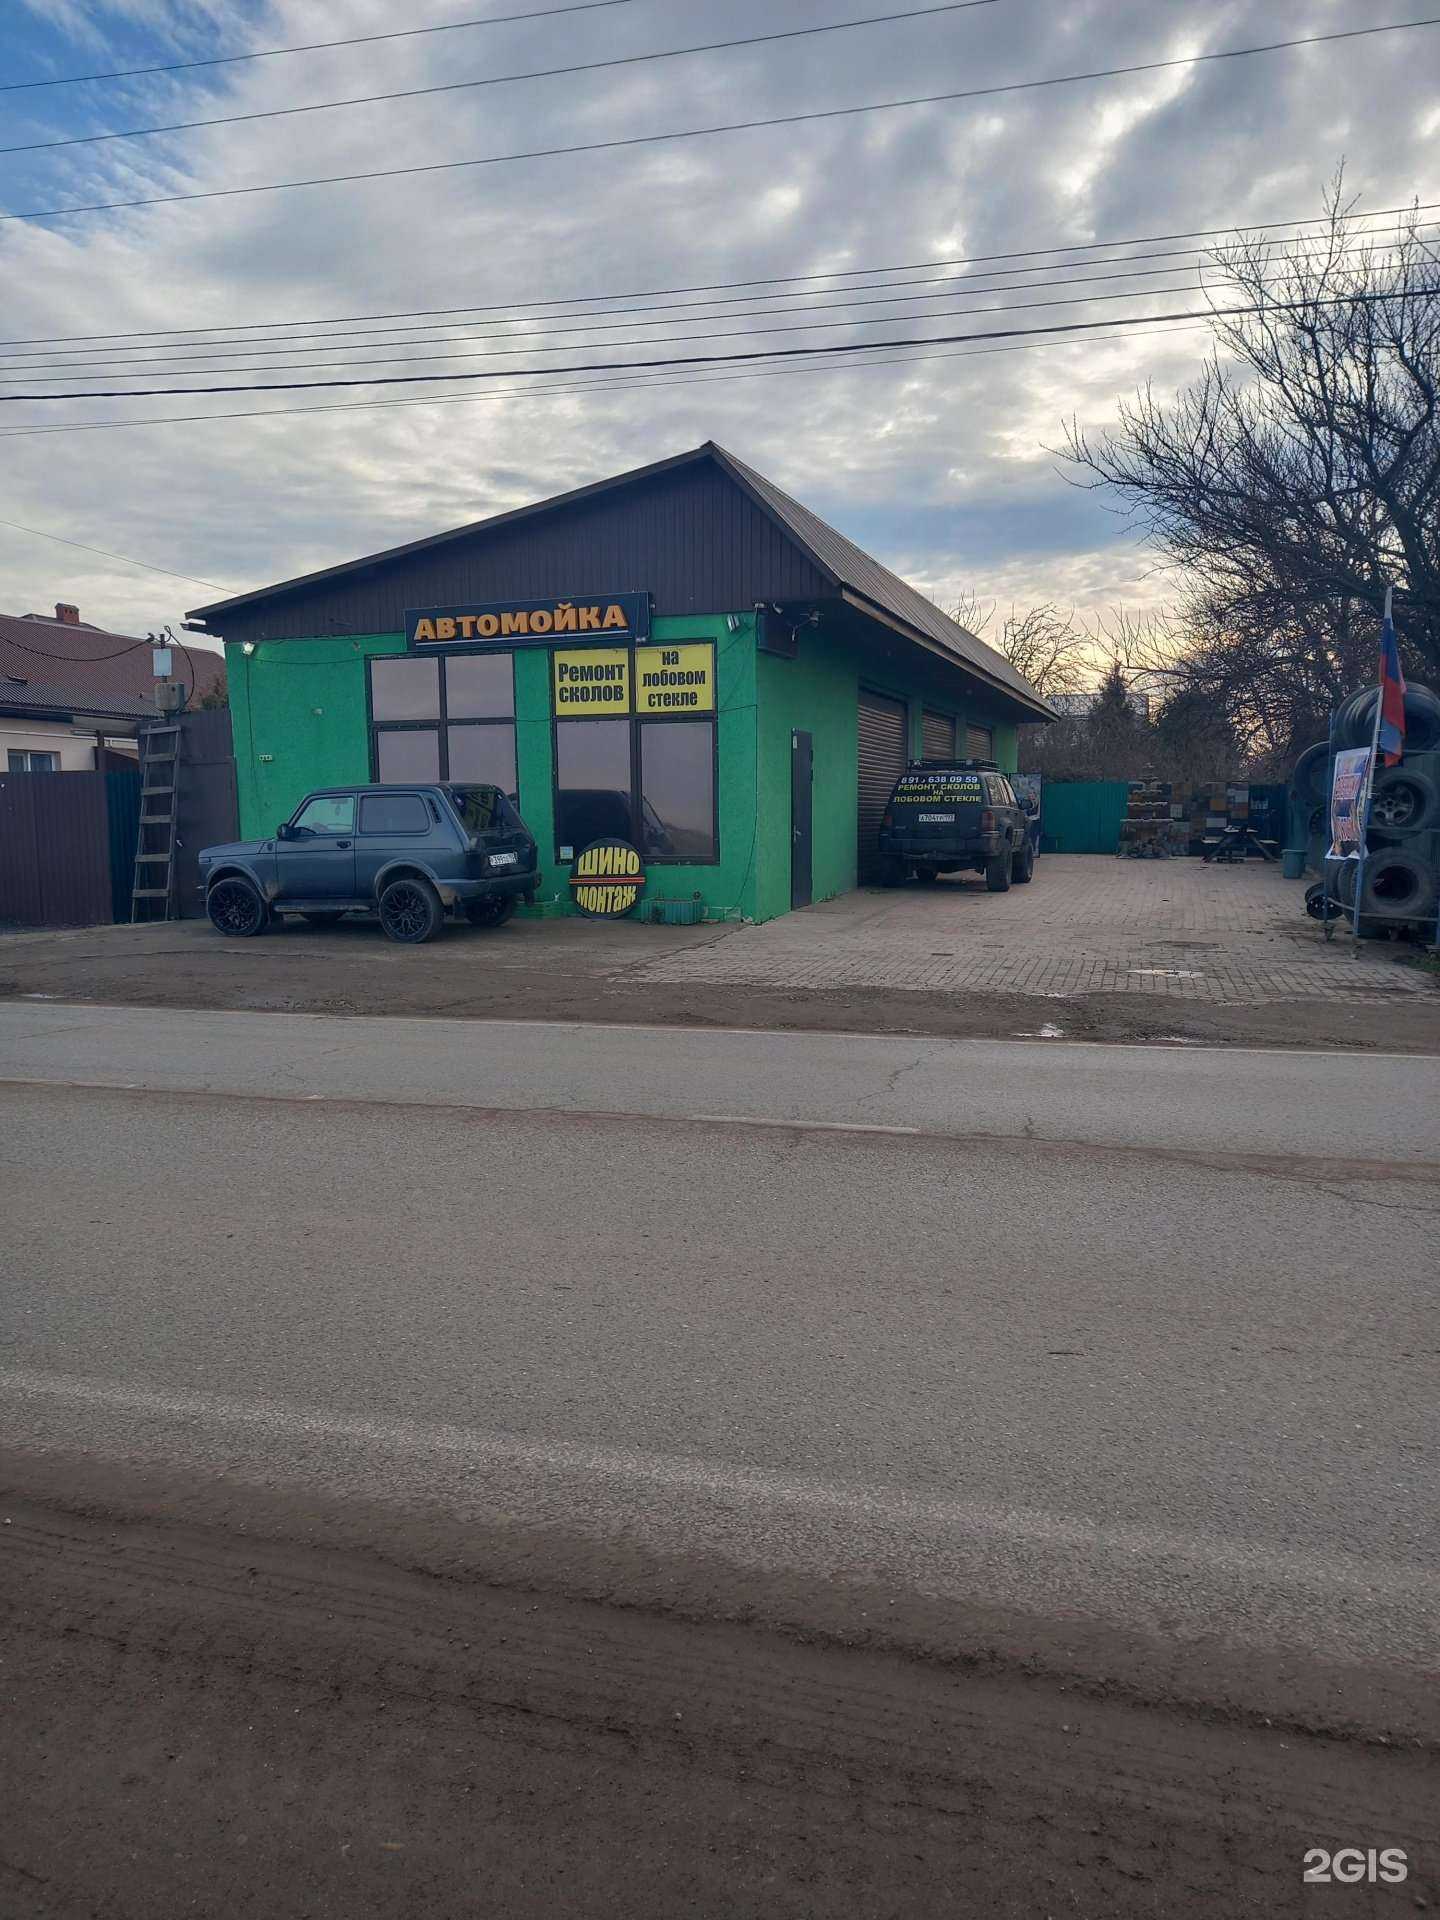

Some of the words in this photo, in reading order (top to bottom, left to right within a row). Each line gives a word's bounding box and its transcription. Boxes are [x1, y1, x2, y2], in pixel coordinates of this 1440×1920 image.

[414, 602, 629, 641] АВТОМОЙКА
[661, 650, 679, 666] на
[558, 663, 625, 683] Ремонт
[642, 669, 706, 688] лобовом
[559, 684, 624, 703] сколов
[648, 690, 698, 708] стекле
[578, 846, 640, 876] ШИНО
